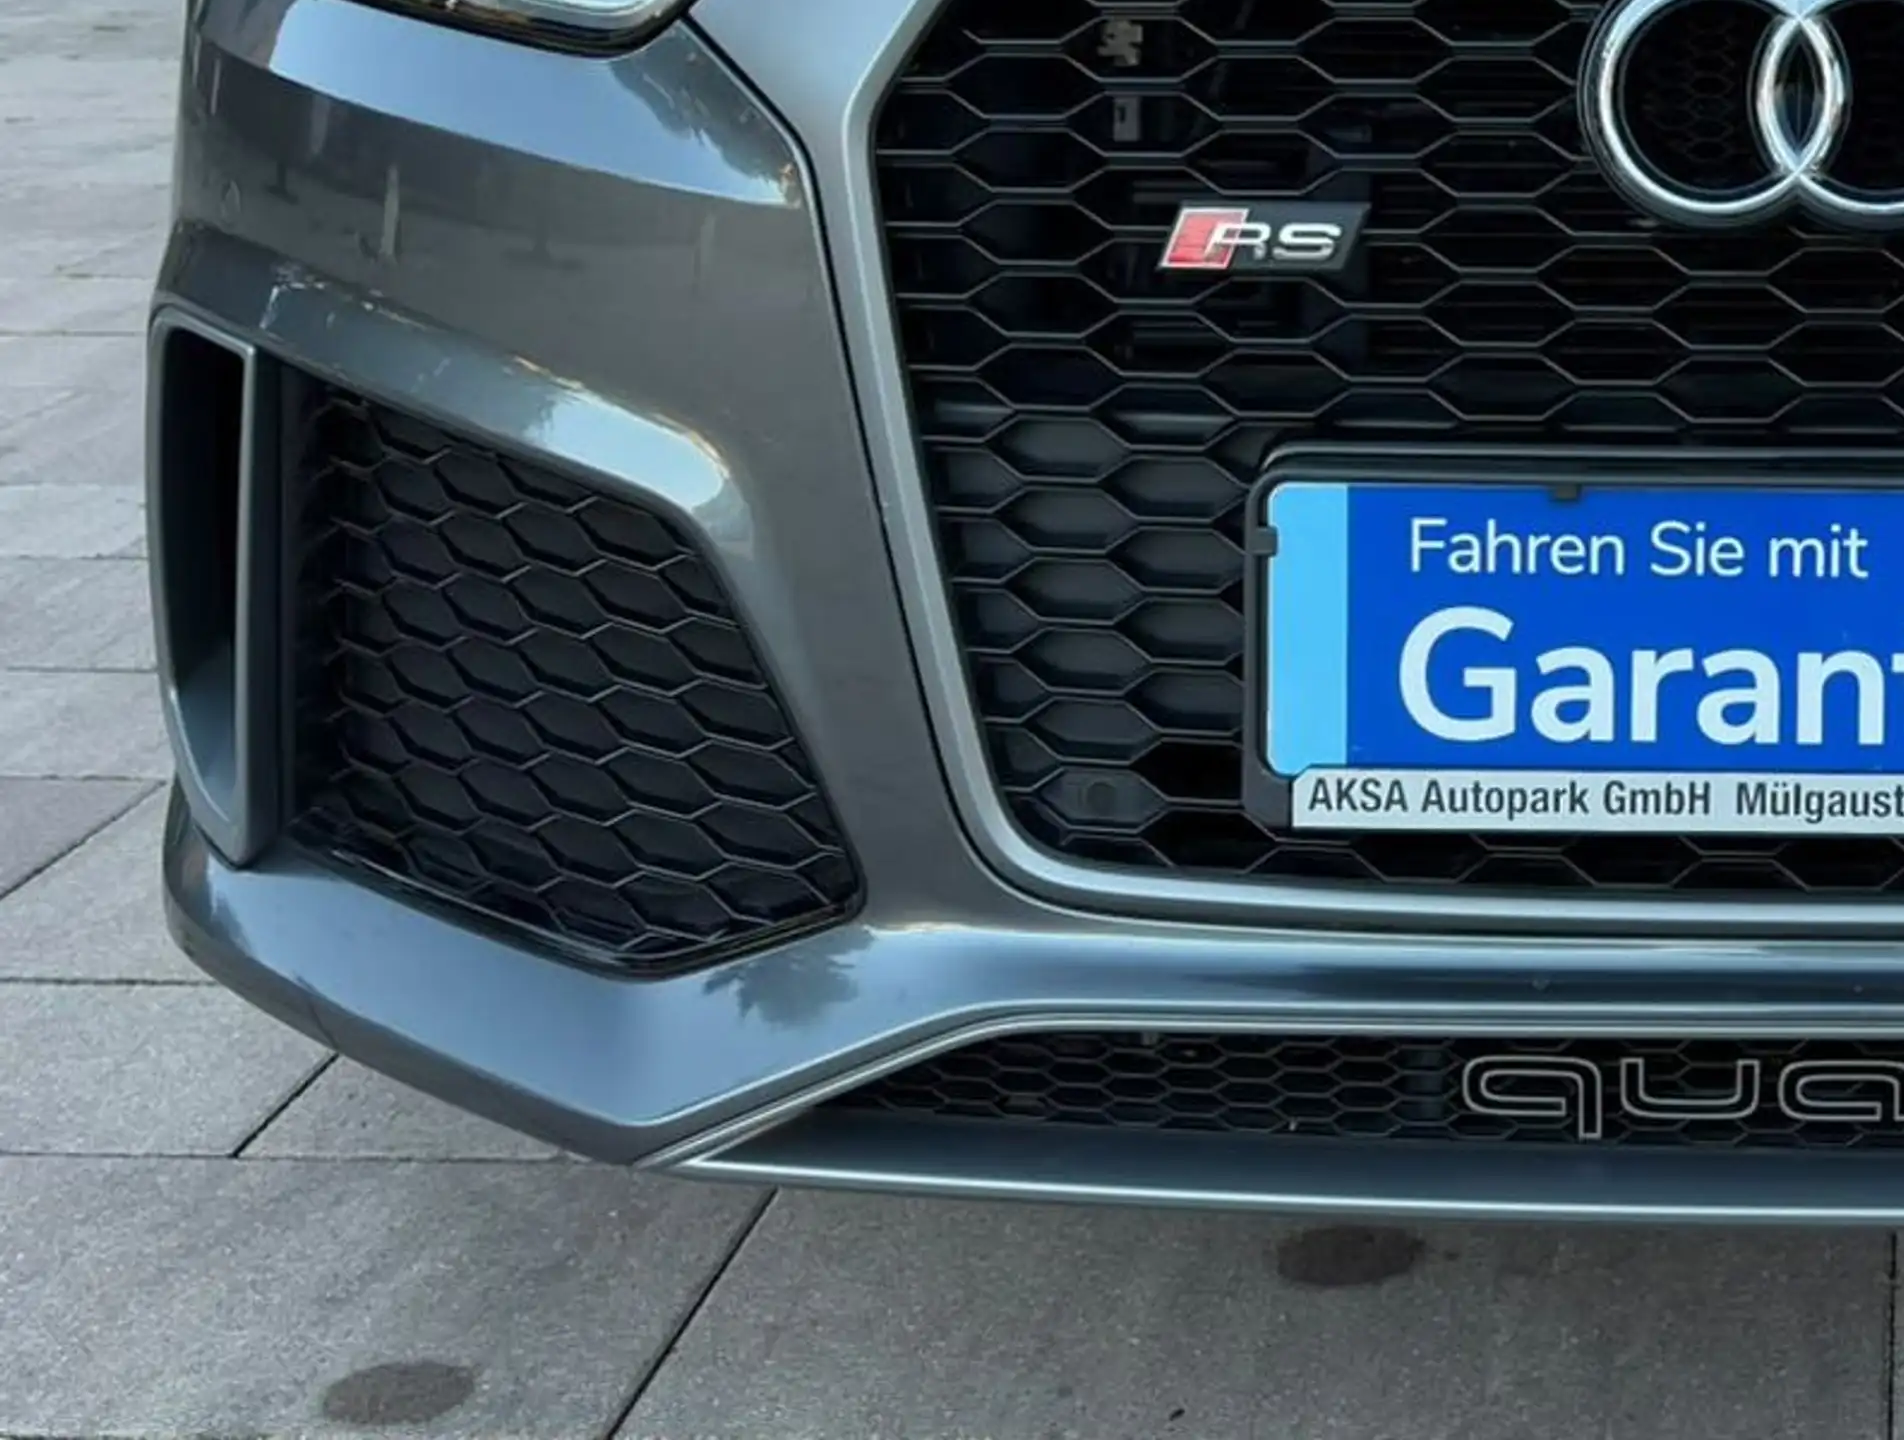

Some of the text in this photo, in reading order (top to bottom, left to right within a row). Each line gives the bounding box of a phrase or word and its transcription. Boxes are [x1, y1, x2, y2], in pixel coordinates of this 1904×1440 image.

[1203, 222, 1342, 262] RS
[1411, 517, 1869, 579] Fahren Sie mit
[1308, 777, 1408, 812] AKSA
[1421, 777, 1589, 824] Autopark
[1602, 779, 1712, 816] GmbH
